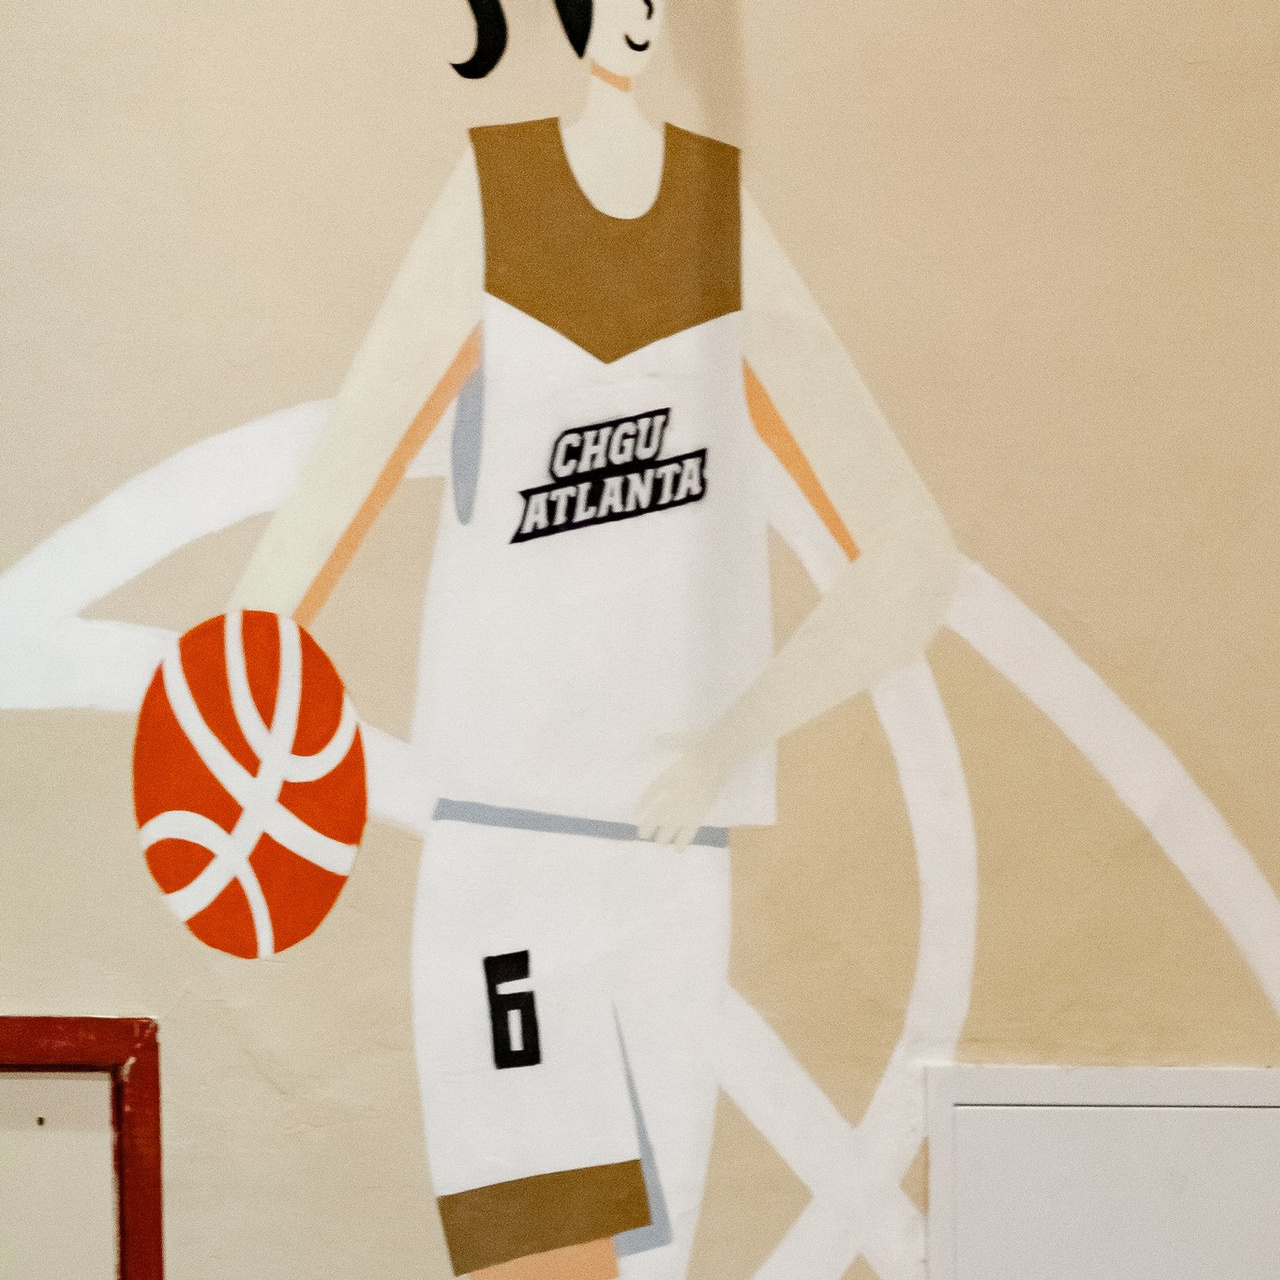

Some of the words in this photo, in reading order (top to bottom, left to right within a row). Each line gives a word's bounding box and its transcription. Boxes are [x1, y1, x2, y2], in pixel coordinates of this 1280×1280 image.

[551, 411, 667, 481] CHGU
[518, 455, 704, 535] ATLANTA
[483, 949, 541, 1070] 6
